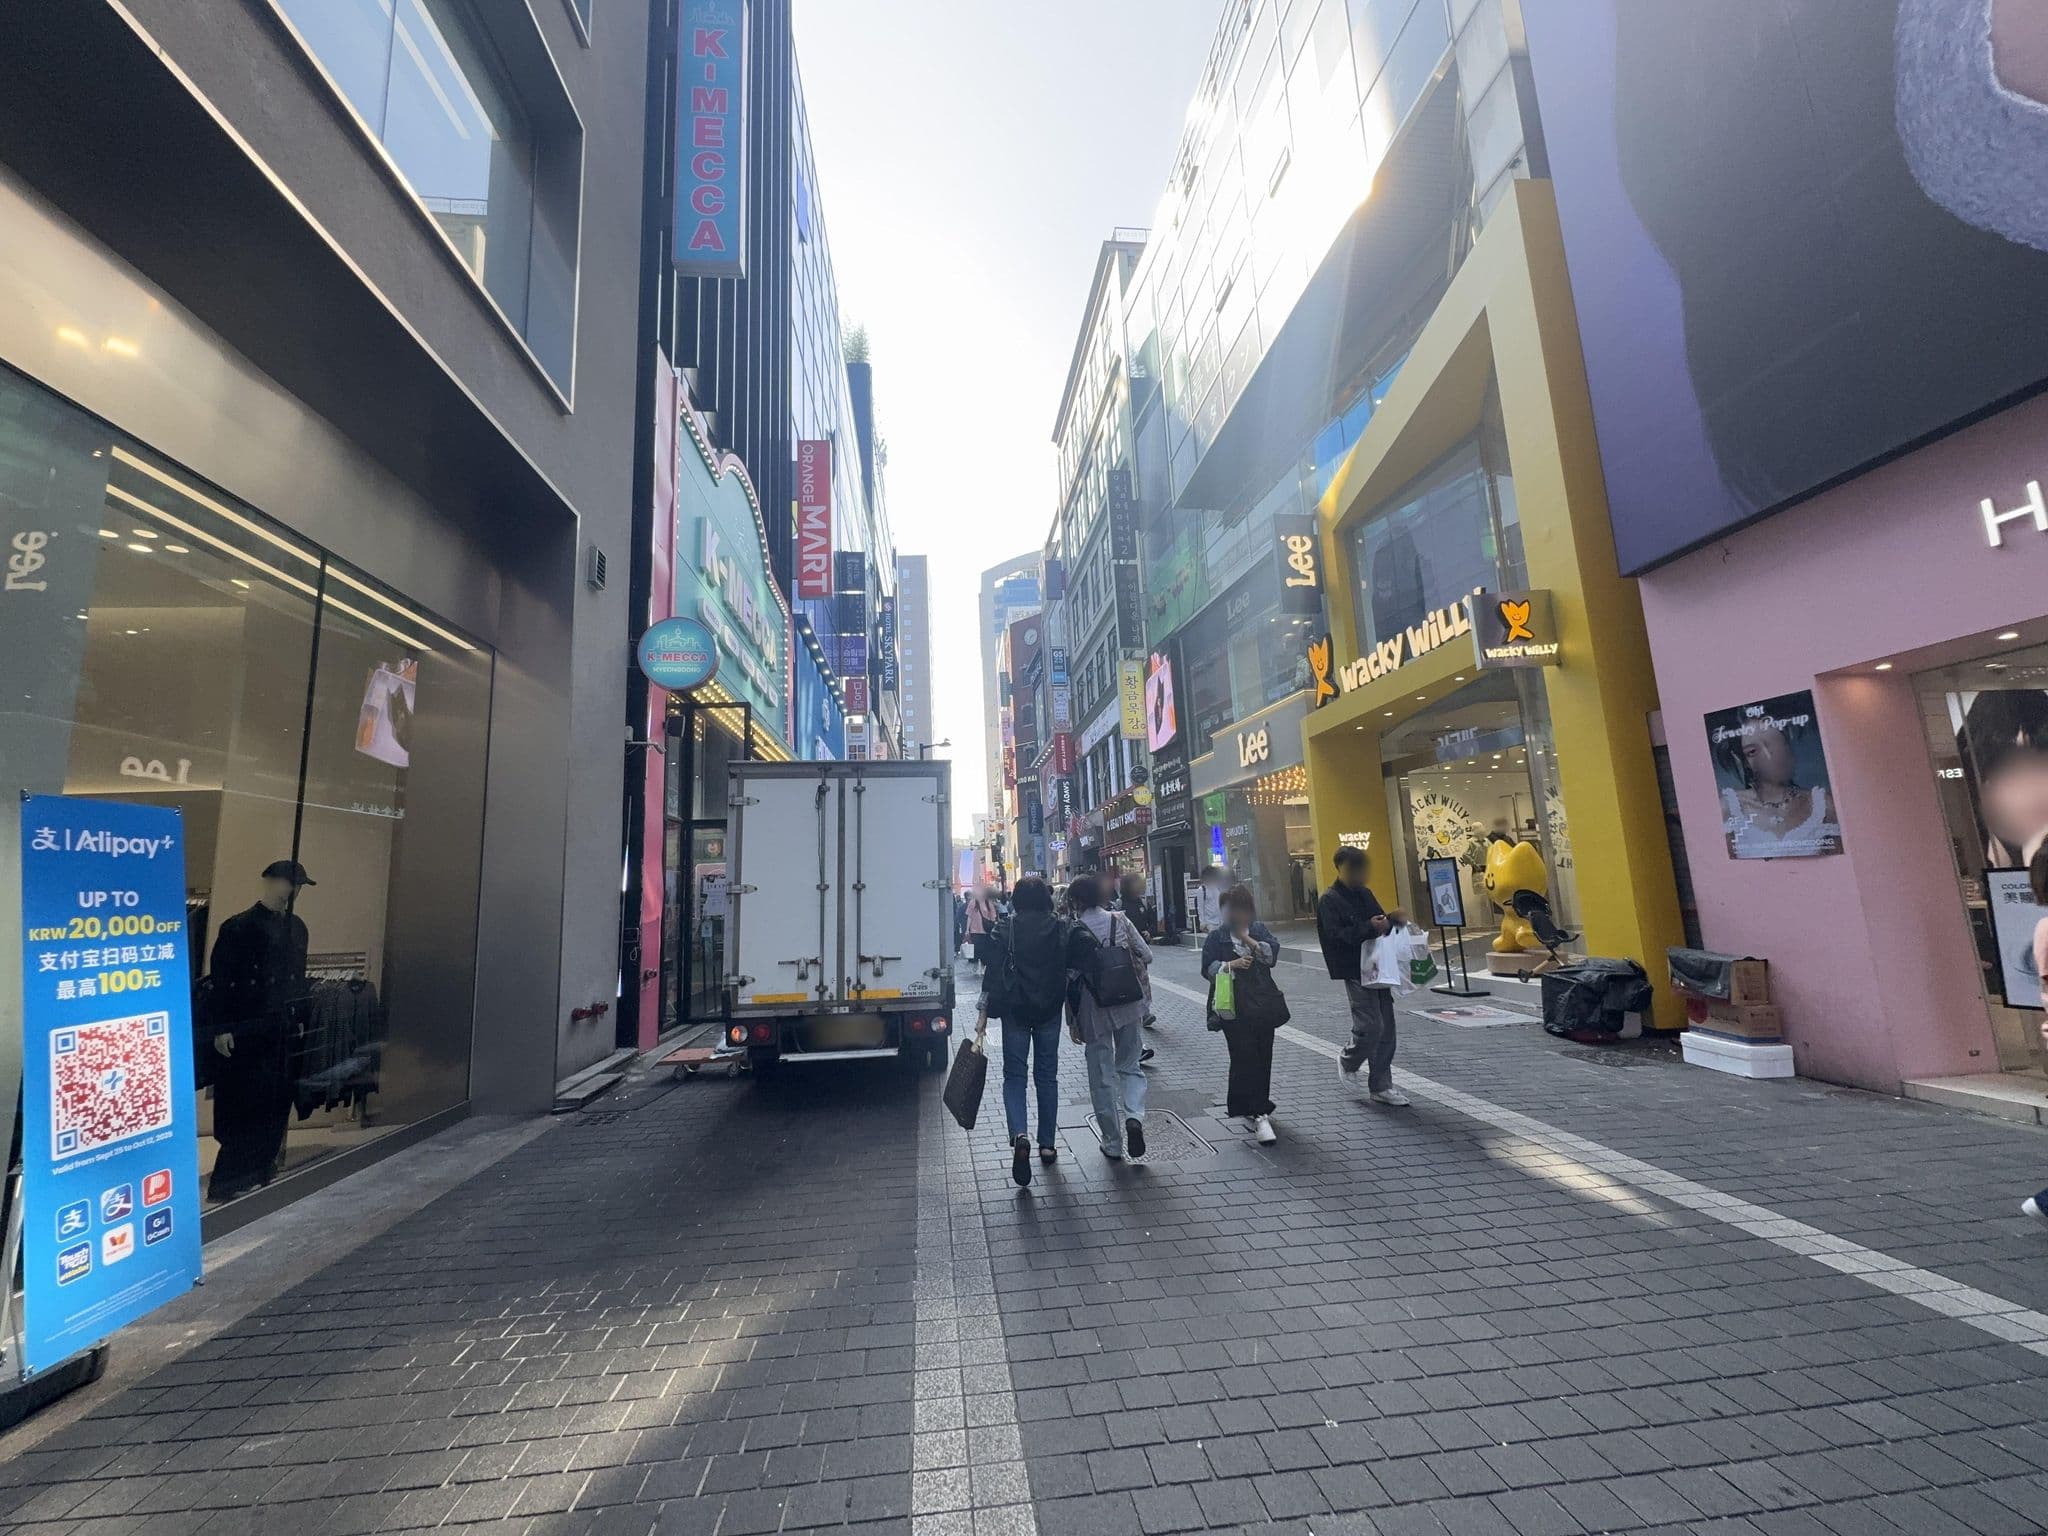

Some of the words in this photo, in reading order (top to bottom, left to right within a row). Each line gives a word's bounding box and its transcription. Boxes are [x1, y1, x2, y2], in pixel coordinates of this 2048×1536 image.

[802, 443, 814, 503] ORANGE
[1981, 480, 2048, 547] H
[802, 505, 828, 592] MART
[1286, 535, 1316, 588] Lee
[648, 653, 707, 662] K-MECCA
[884, 636, 894, 683] SKYPARK
[1053, 650, 1063, 658] GS
[1125, 675, 1140, 730] 황금목장
[1712, 724, 1756, 744] Jewelry
[1761, 714, 1809, 730] Pop-up
[1238, 729, 1268, 768] Lee
[1063, 781, 1071, 804] SAVOY
[79, 891, 107, 908] UP
[112, 891, 139, 906] TO
[29, 928, 67, 941] KRW
[69, 915, 154, 940] 20,000
[157, 921, 181, 934] OFF
[39, 943, 175, 973] 支付宝扫码立减
[57, 969, 161, 1000] 最高100元
[53, 1162, 75, 1176] Valid
[75, 1157, 95, 1168] from
[132, 1140, 146, 1150] Oct
